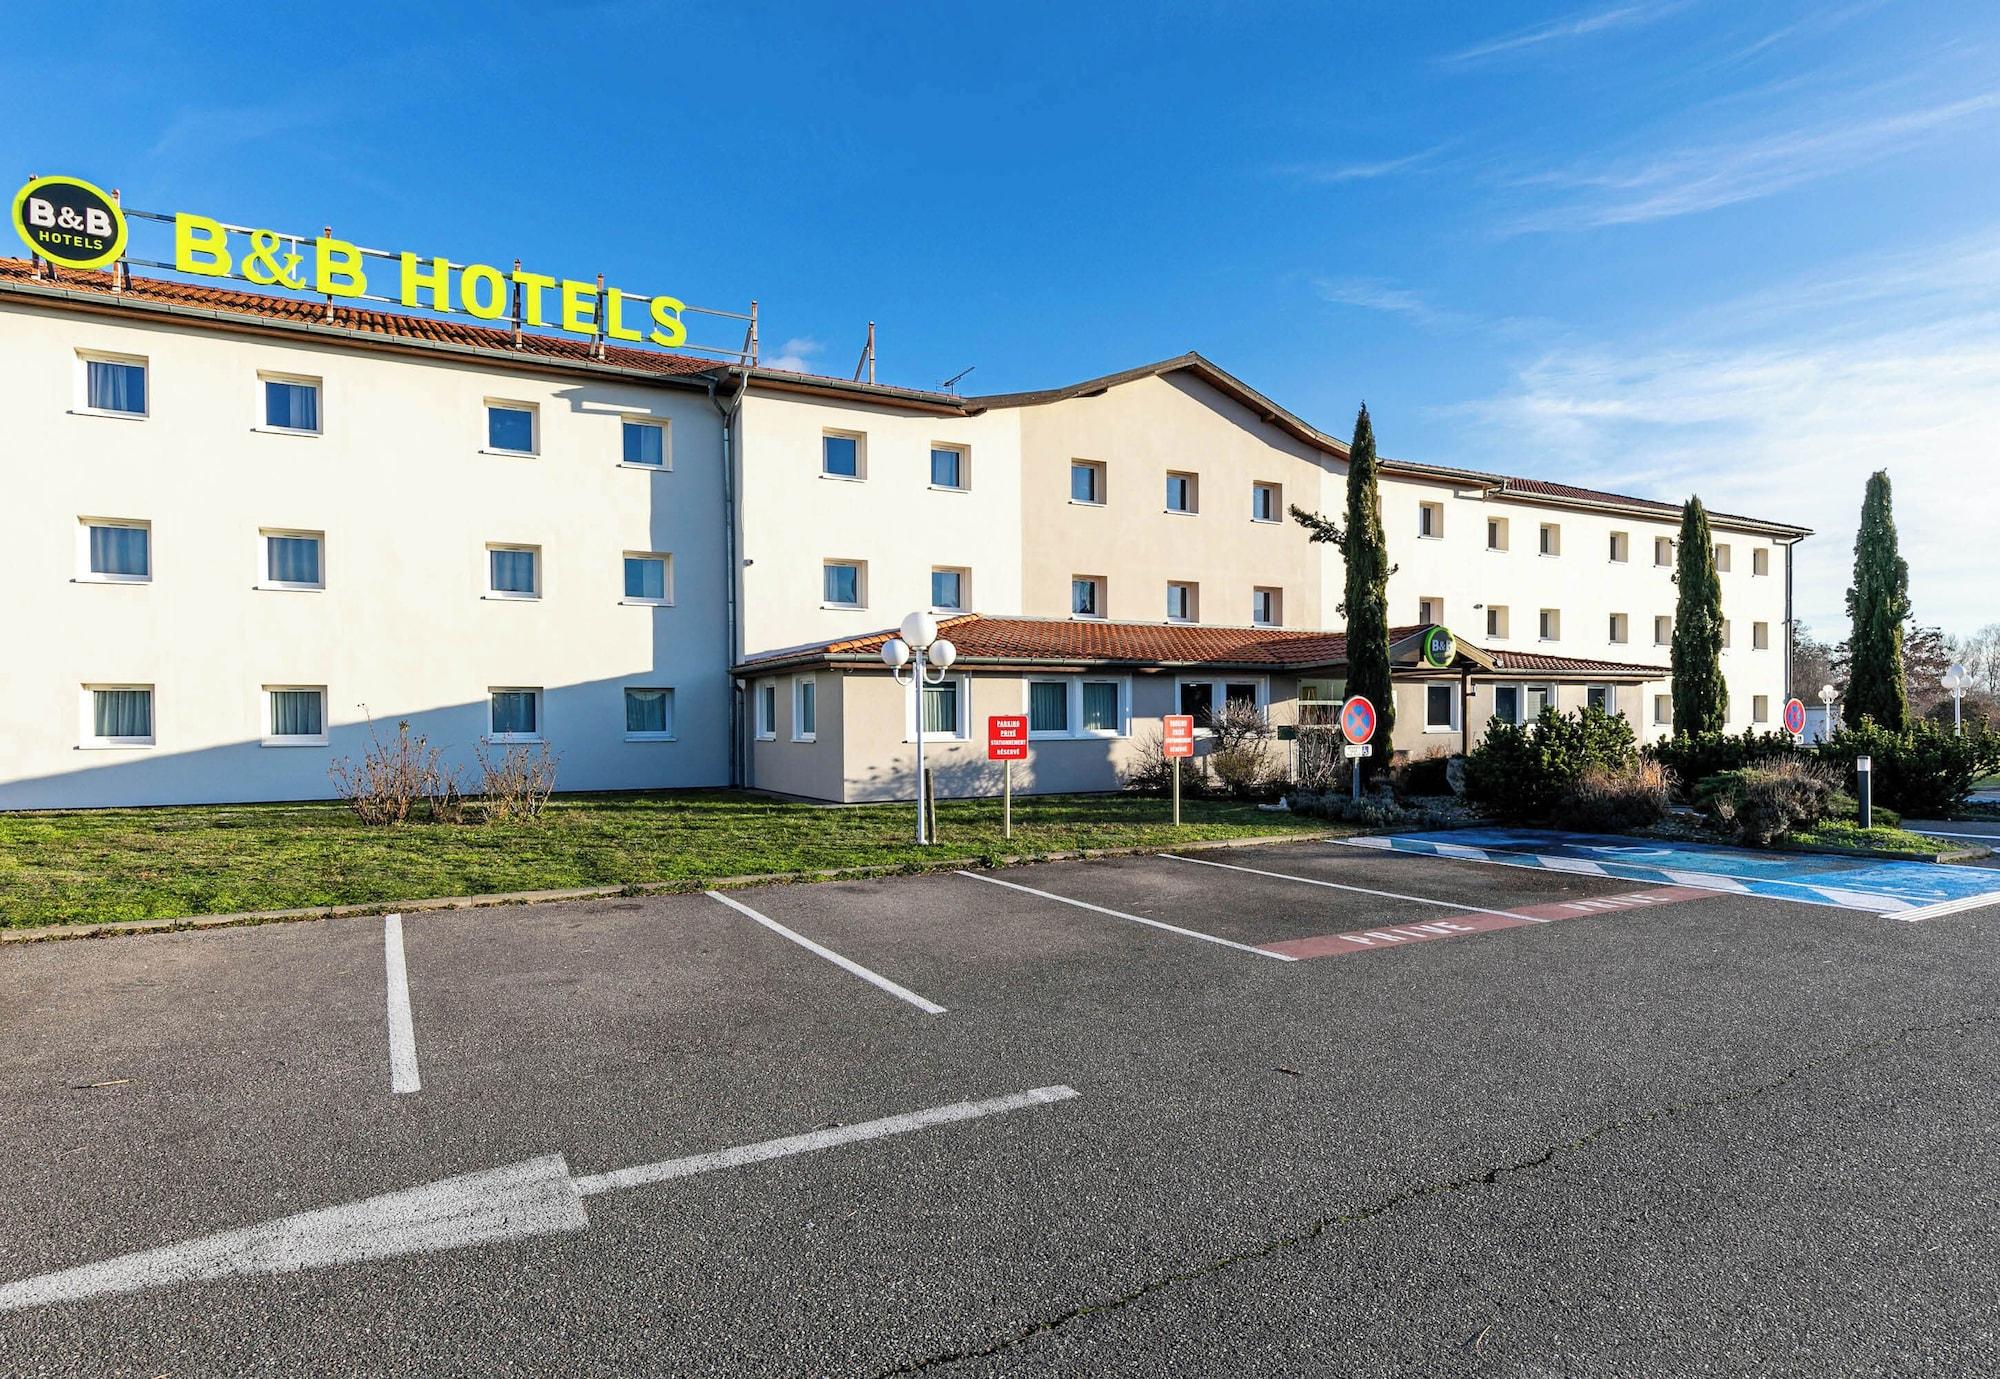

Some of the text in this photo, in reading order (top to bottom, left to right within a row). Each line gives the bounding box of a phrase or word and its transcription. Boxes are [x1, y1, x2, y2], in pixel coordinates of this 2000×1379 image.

[29, 197, 113, 238] B&B
[38, 230, 103, 250] HOTELS
[175, 212, 688, 348] B&B HOTELS
[996, 720, 1020, 728] PARKING
[1339, 921, 1476, 946] PRIVE
